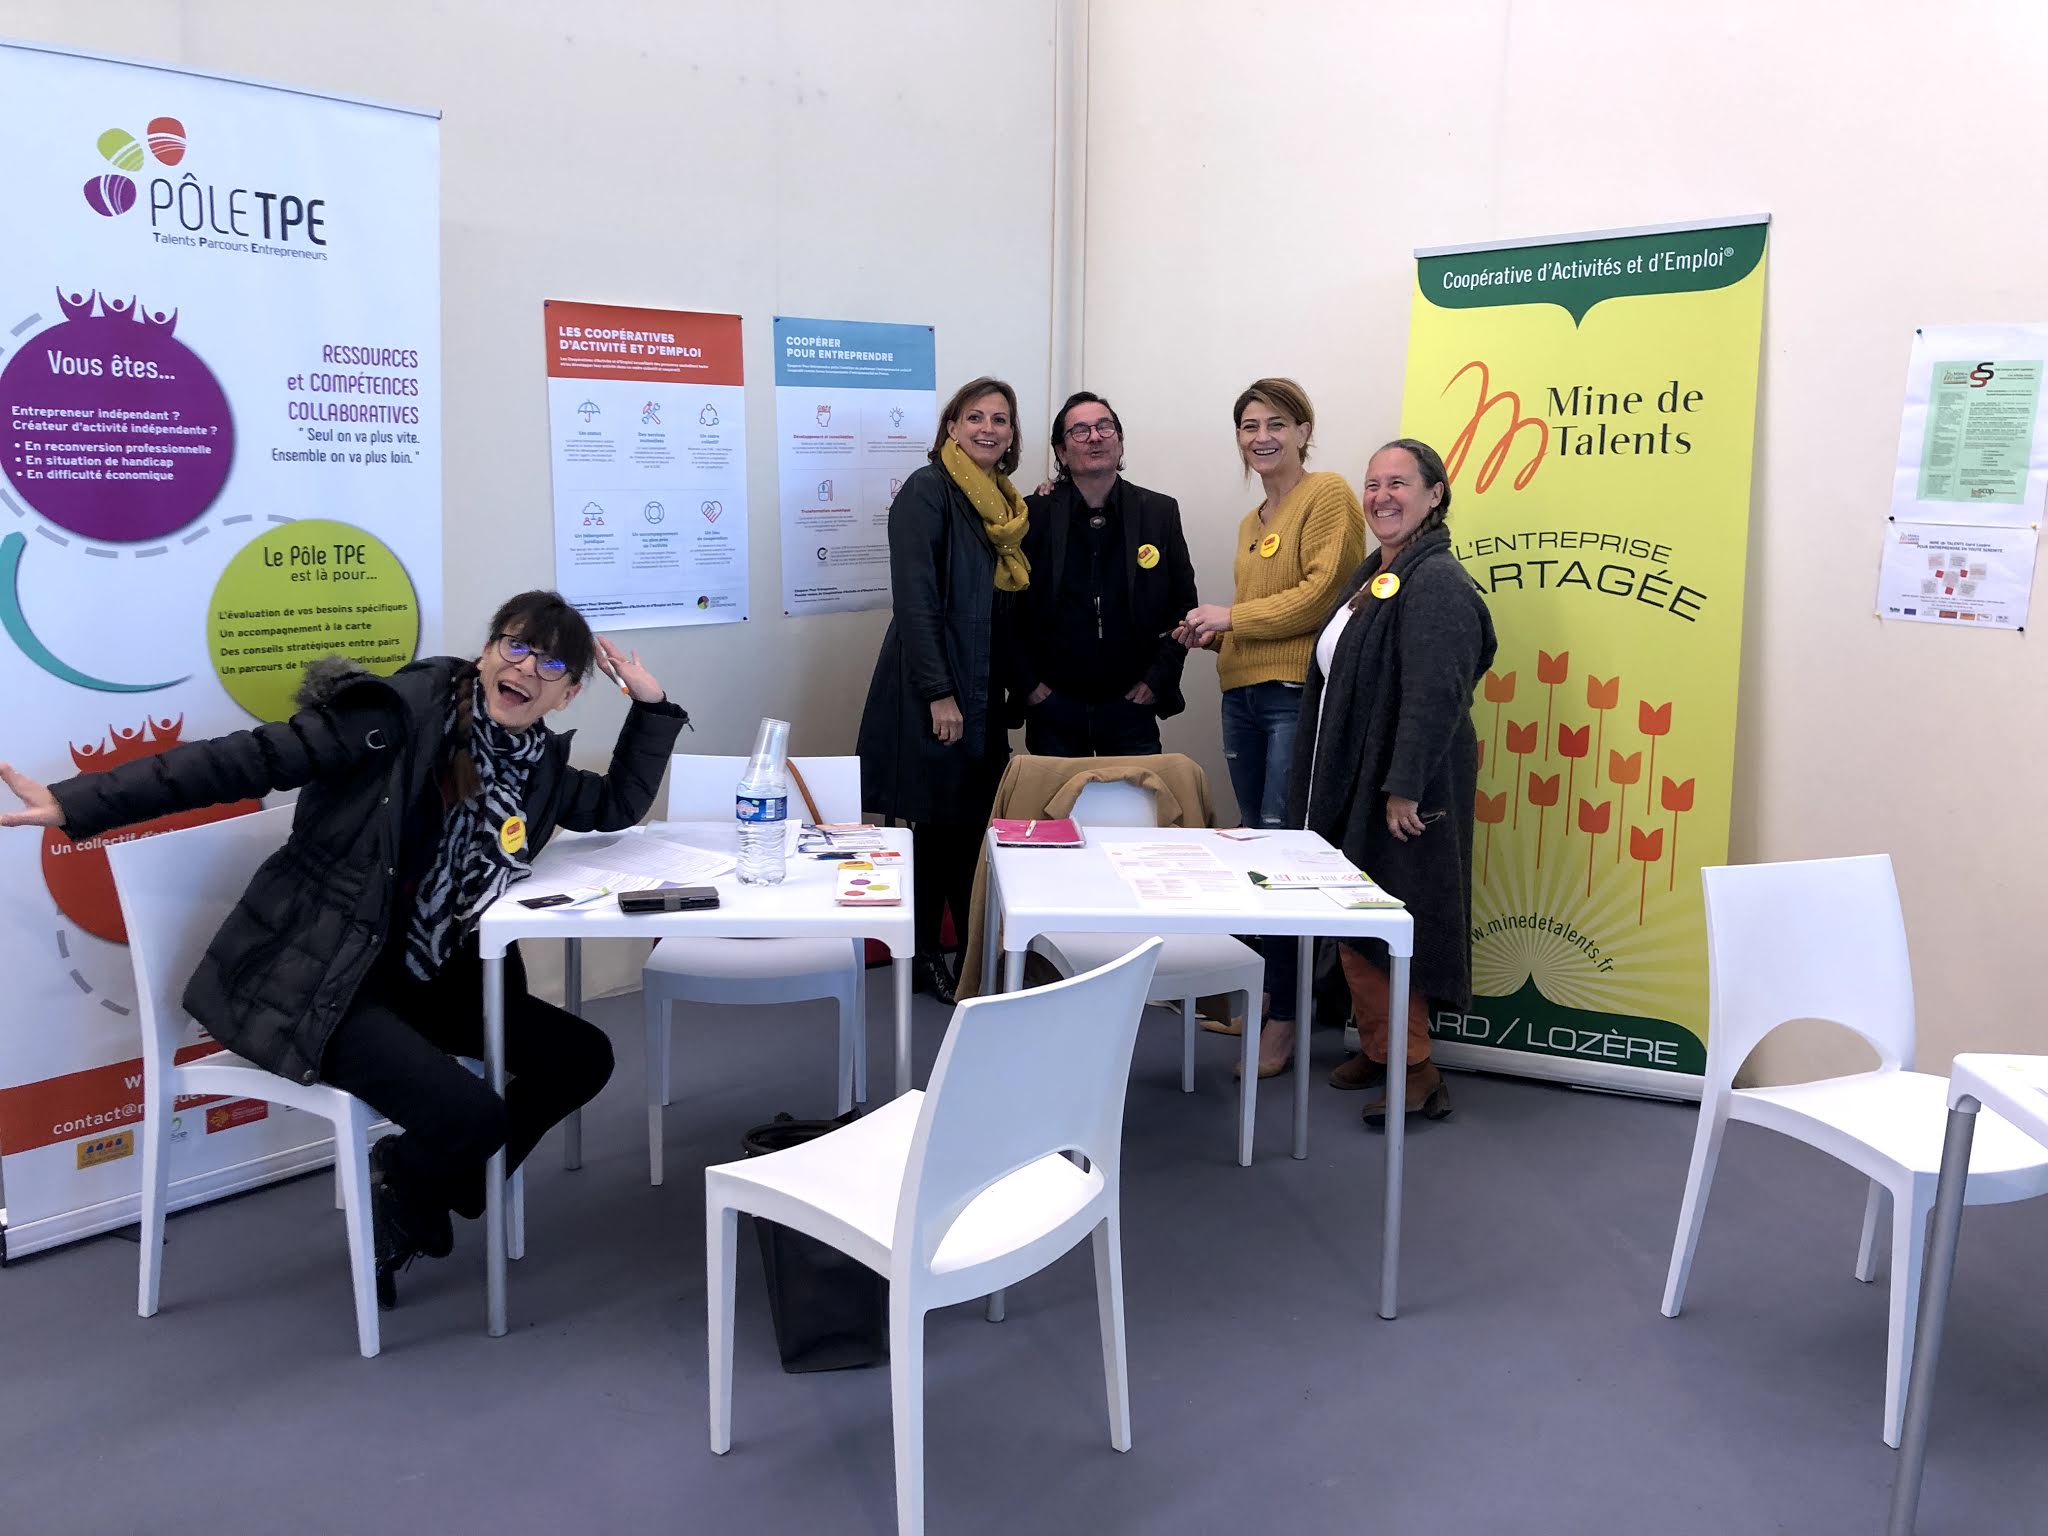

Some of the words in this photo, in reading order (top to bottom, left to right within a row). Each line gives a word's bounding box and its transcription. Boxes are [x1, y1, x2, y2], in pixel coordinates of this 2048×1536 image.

[153, 232, 196, 247] Talents
[199, 237, 249, 253] Parcours
[251, 242, 328, 261] Entrepreneurs
[1443, 265, 1532, 290] Coopérative
[1538, 258, 1622, 282] d'Activités
[1627, 259, 1643, 273] et
[559, 326, 580, 336] LES
[585, 328, 675, 343] COOPÉRATIVES
[786, 336, 840, 347] COOPÉRER
[323, 344, 418, 368] RESSOURCES
[560, 340, 626, 353] D'ACTIVITÉ
[630, 344, 644, 354] ET
[648, 345, 701, 357] D'EMPLOI
[787, 349, 815, 358] POUR
[819, 350, 893, 361] ENTREPRENDRE
[48, 350, 103, 376] Vous
[111, 354, 175, 380] êtes...
[288, 374, 304, 391] et
[310, 372, 418, 396] COMPÉTENCES
[1547, 386, 1643, 417] Mine
[1657, 381, 1704, 414] de
[12, 406, 94, 418] Entrepreneur
[98, 408, 169, 420] indépendant
[289, 402, 418, 424] COLLABORATIVES
[13, 420, 68, 431] Créateur
[72, 422, 128, 433] d'activité
[131, 424, 207, 435] indépendante
[308, 428, 333, 441] Seul
[338, 430, 351, 442] on
[355, 431, 367, 442] va
[371, 430, 393, 445] plus
[1552, 423, 1692, 456] Talents
[25, 441, 41, 451] En
[45, 442, 122, 453] reconversion
[126, 444, 211, 454] professionnelle
[26, 455, 42, 465] En
[46, 456, 101, 466] situation
[105, 457, 118, 466] de
[122, 457, 173, 468] handicap
[272, 448, 326, 462] Ensemble
[331, 452, 345, 462] on
[350, 453, 361, 463] va
[366, 451, 386, 465] plus
[27, 470, 43, 479] En
[47, 470, 102, 480] difficulté
[106, 470, 174, 482] économique
[264, 547, 283, 567] Le
[290, 545, 327, 566] Pôle
[333, 545, 366, 565] TPE
[1456, 532, 1672, 564] L'ENTREPRISE
[291, 570, 311, 582] est
[316, 568, 328, 581] là
[333, 570, 377, 582] pour...
[1474, 560, 1706, 622] RTAGÉE
[219, 610, 280, 620] L'évaluation
[284, 607, 294, 616] de
[316, 605, 352, 614] besoins
[356, 603, 408, 614] spécifiques
[220, 630, 234, 638] Un
[325, 623, 330, 631] à
[334, 622, 342, 630] la
[345, 622, 371, 630] carte
[221, 648, 239, 656] Des
[243, 644, 283, 655] conseils
[287, 640, 345, 653] stratégiques
[349, 639, 375, 648] entre
[378, 638, 400, 648] pairs
[222, 666, 235, 674] Un
[239, 663, 282, 674] parcours
[286, 662, 297, 670] de
[349, 653, 406, 665] ndividualisé
[51, 844, 71, 855] Un
[1471, 912, 1614, 973] w.minedetalents.fr
[1428, 1011, 1490, 1038] RD
[1527, 1022, 1678, 1066] LOZÈRE
